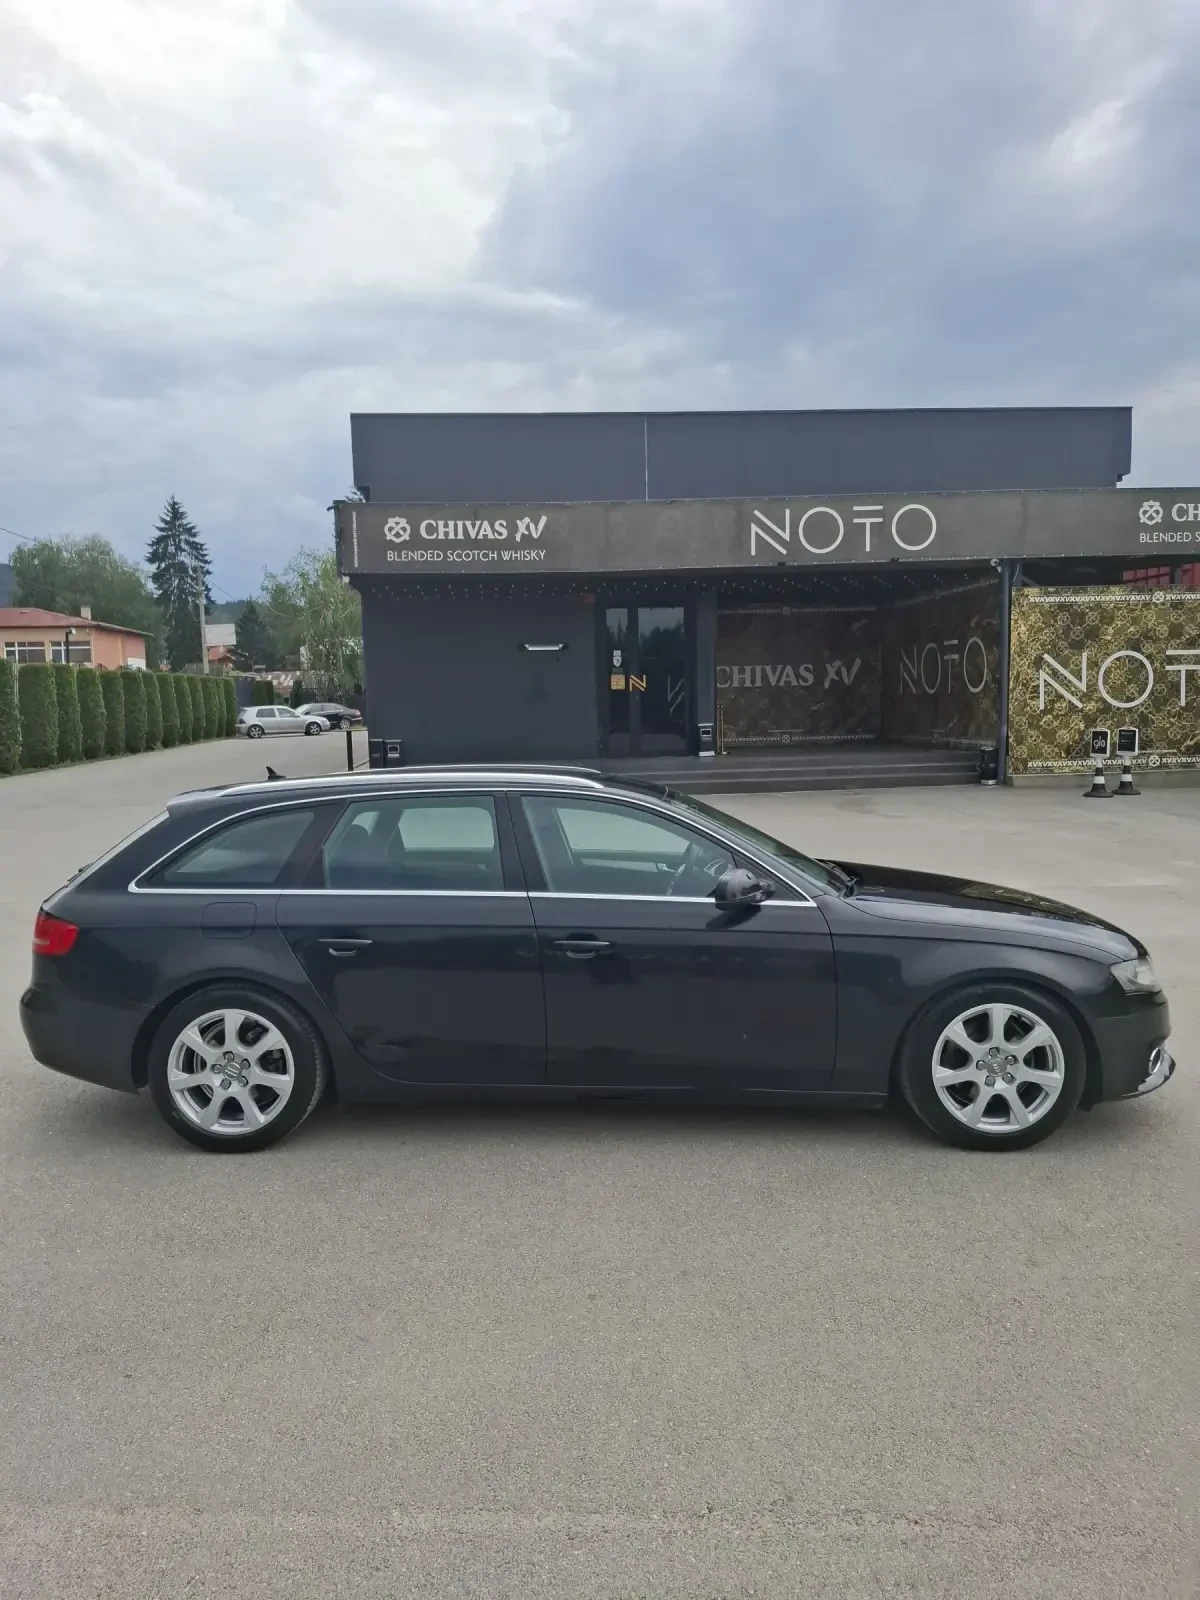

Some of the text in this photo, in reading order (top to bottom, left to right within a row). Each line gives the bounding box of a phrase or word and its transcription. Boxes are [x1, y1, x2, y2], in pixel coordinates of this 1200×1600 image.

[419, 515, 547, 543] CHIVAS XV
[750, 503, 937, 556] NOTO
[1139, 532, 1192, 543] BLENDED
[386, 549, 546, 562] BLENDED SCOTCH WHISKY
[716, 657, 862, 690] CHIVAS XV
[899, 636, 987, 694] NOTO
